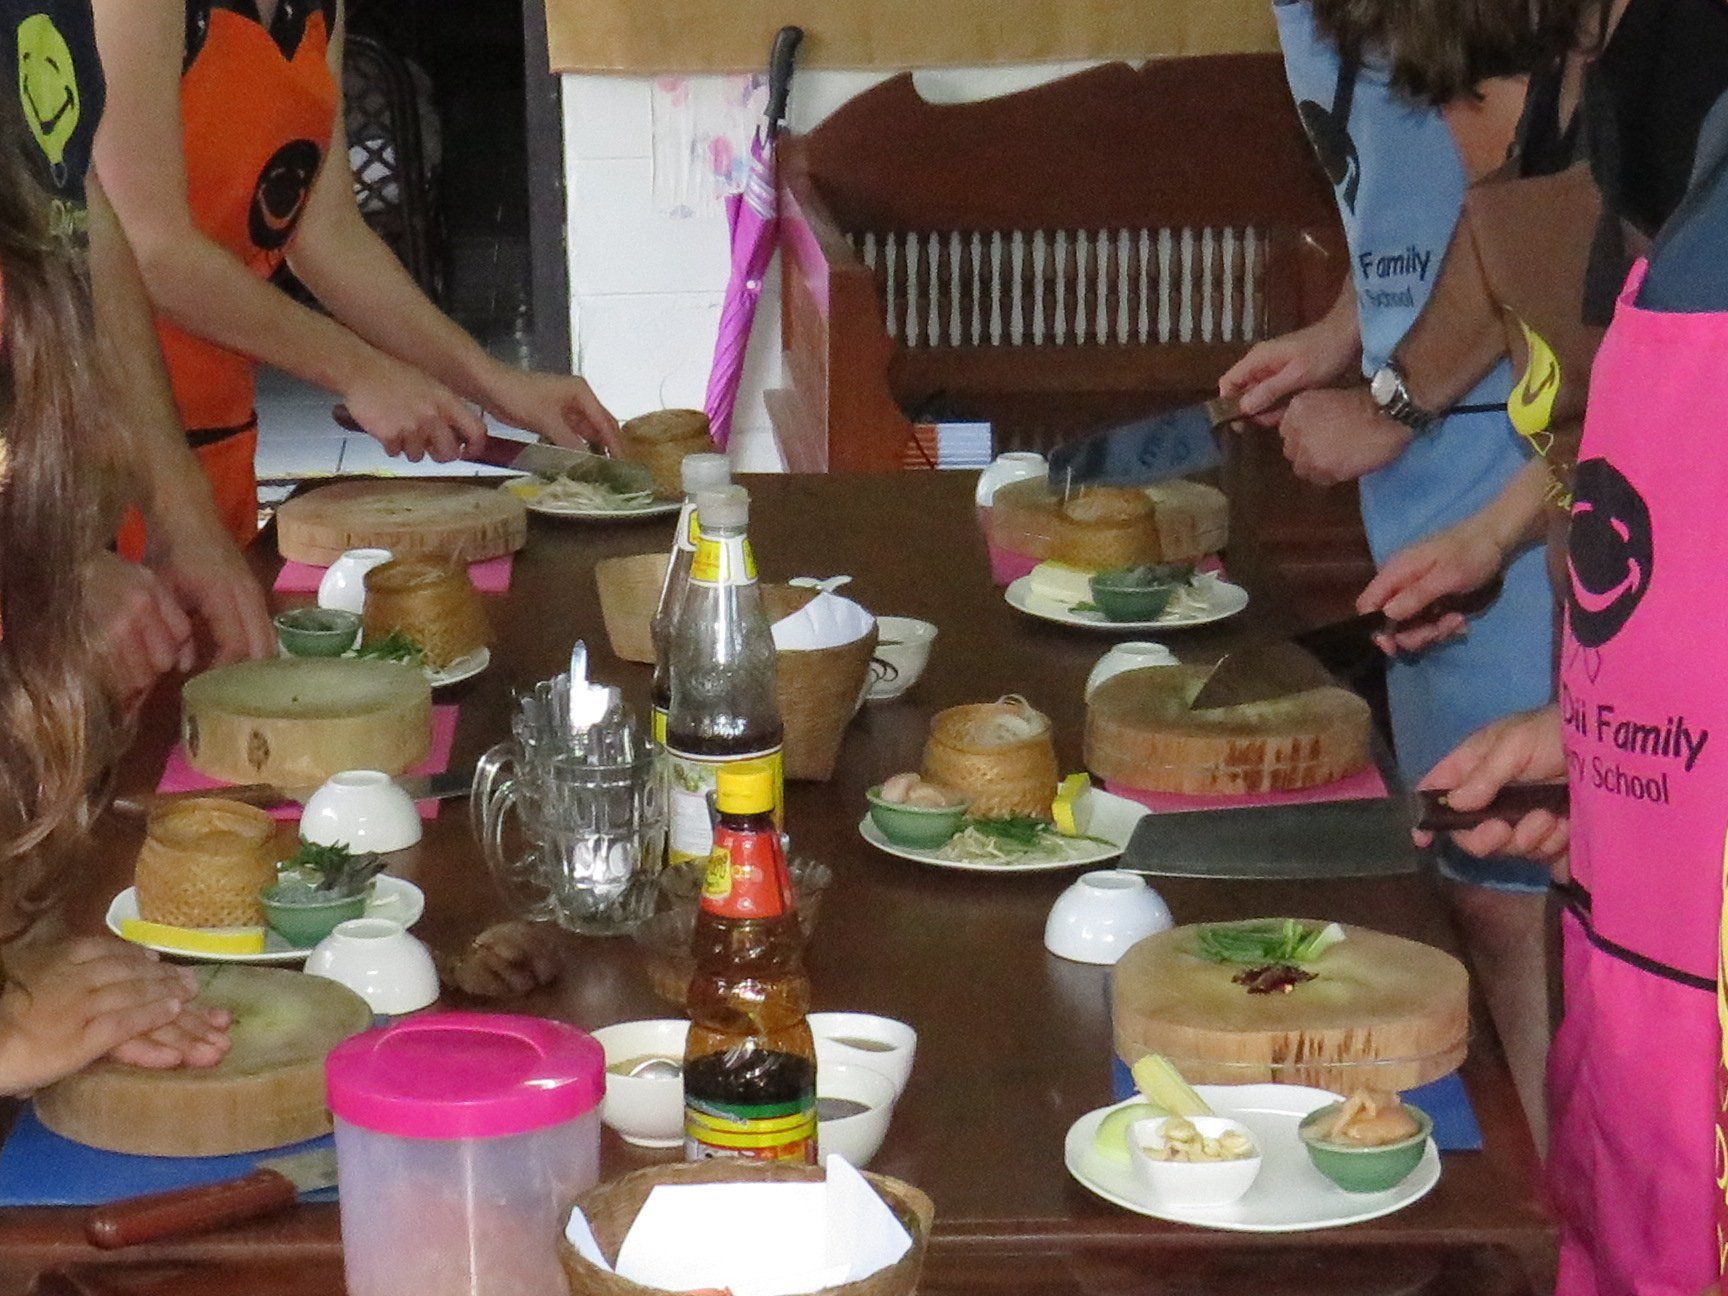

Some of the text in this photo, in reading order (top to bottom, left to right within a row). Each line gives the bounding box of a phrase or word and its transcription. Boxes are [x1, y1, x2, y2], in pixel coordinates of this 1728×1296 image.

[1358, 245, 1431, 282] Family
[1596, 705, 1709, 772] Family
[1592, 755, 1670, 805] School
